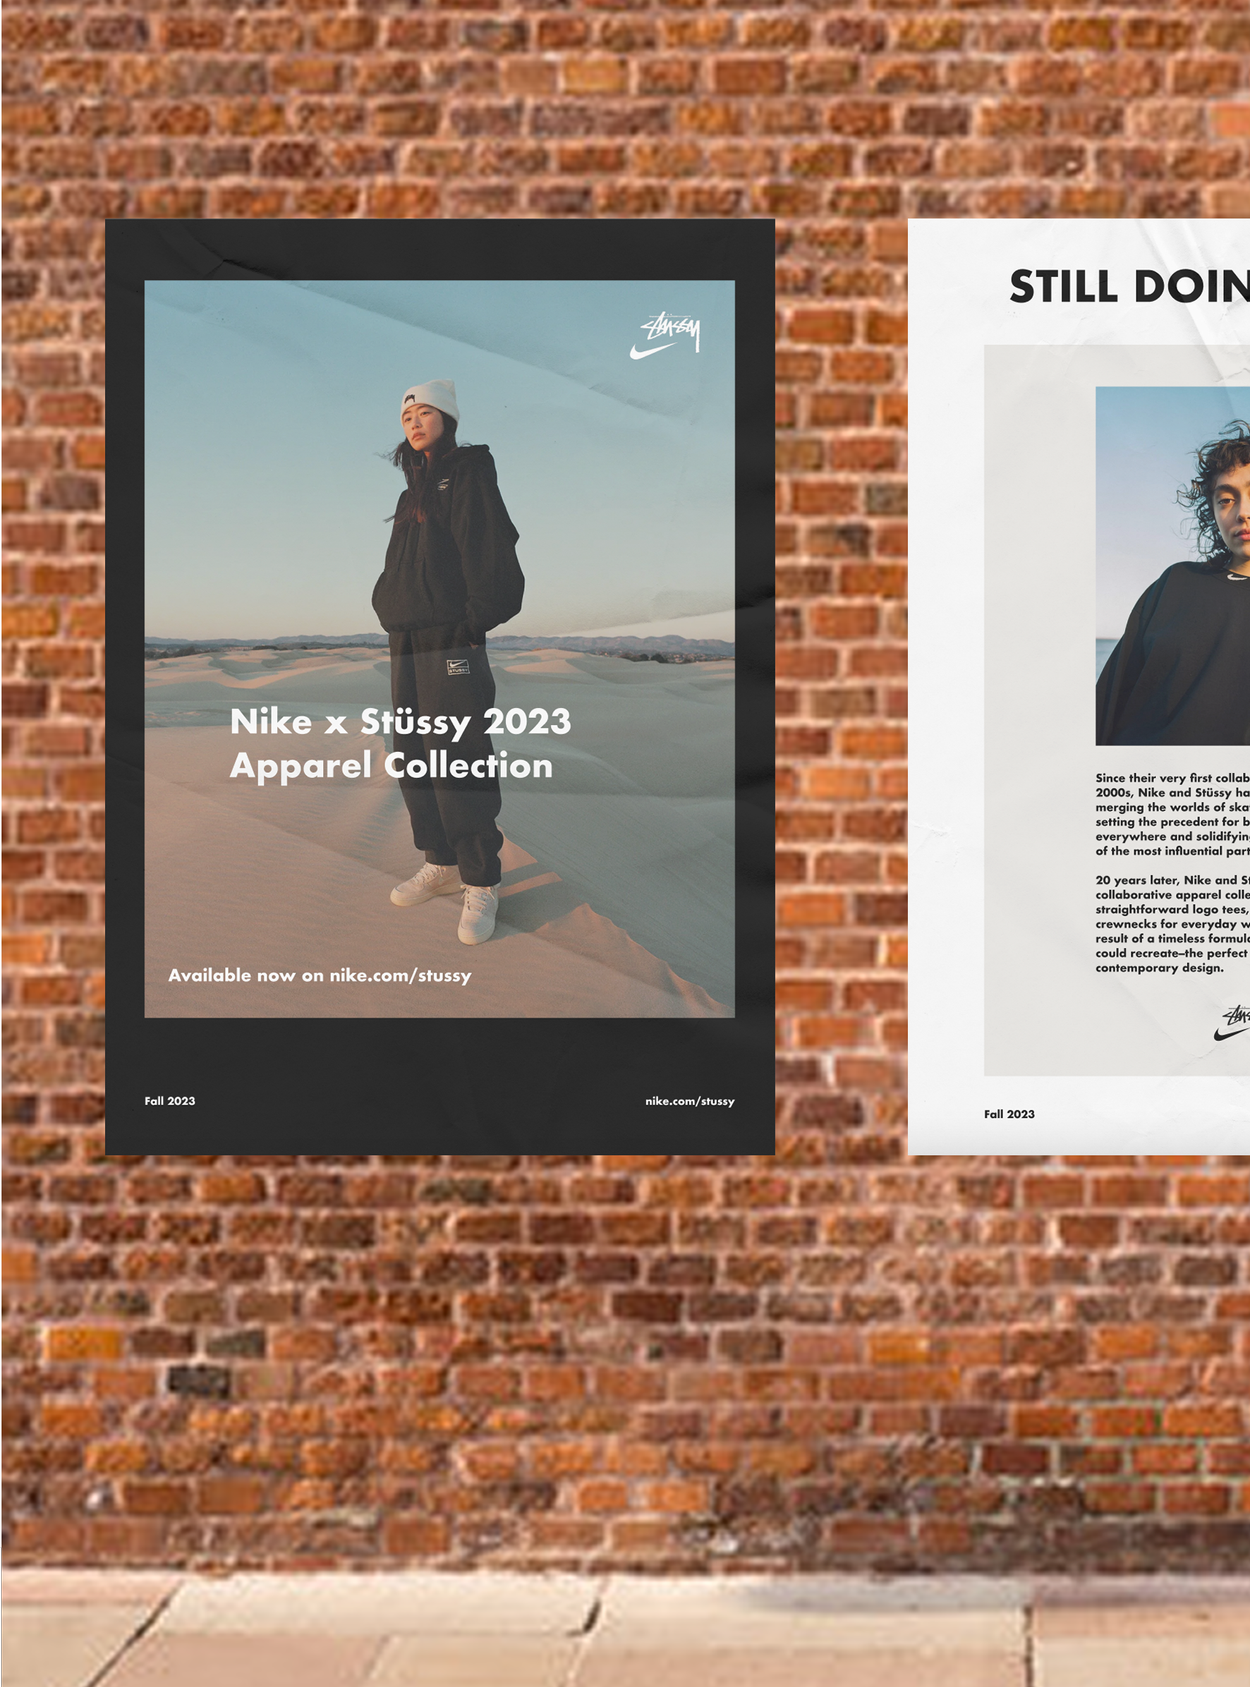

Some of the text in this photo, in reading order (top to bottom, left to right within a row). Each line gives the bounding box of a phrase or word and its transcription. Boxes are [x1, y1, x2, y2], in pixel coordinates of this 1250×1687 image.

[1010, 269, 1117, 303] STILL
[232, 706, 571, 742] Nike x Stüssy 2023
[230, 750, 552, 786] Apparel Collection
[1095, 772, 1126, 783] Since
[1128, 772, 1157, 783] their
[1159, 775, 1187, 786] very
[1189, 772, 1213, 783] first
[1095, 787, 1134, 799] 2000s,
[1138, 786, 1166, 798] Nike
[1168, 786, 1192, 798] and
[1195, 787, 1233, 800] Stüssy
[1095, 801, 1145, 815] merging
[1147, 801, 1167, 813] the
[1169, 801, 1210, 813] worlds
[1213, 801, 1226, 812] of
[1095, 816, 1135, 830] setting
[1138, 816, 1158, 827] the
[1160, 816, 1220, 830] precedent
[1221, 816, 1240, 827] for
[1095, 830, 1167, 844] everywhere
[1170, 830, 1193, 842] and
[1095, 845, 1109, 856] of
[1110, 845, 1130, 856] the
[1133, 847, 1162, 856] most
[1164, 845, 1223, 856] influential
[1095, 875, 1111, 885] 20
[1113, 877, 1147, 888] years
[1150, 874, 1180, 887] later,
[1184, 874, 1212, 886] Nike
[1214, 874, 1238, 885] and
[1095, 889, 1173, 900] collaborative
[1175, 889, 1222, 903] apparel
[1095, 903, 1189, 917] straightforward
[1192, 903, 1219, 917] logo
[1221, 905, 1250, 916] tees,
[1095, 918, 1158, 929] crewnecks
[1160, 918, 1178, 929] for
[1181, 918, 1238, 932] everyday
[1095, 932, 1129, 944] result
[1131, 932, 1144, 944] of
[1146, 936, 1155, 944] a
[1157, 932, 1206, 944] timeless
[1095, 947, 1127, 958] could
[1207, 947, 1249, 961] perfect
[1095, 962, 1225, 976] contemporary design.
[167, 966, 473, 987] Available now on nike.com/stussy
[144, 1095, 196, 1106] Fall 2023
[645, 1095, 736, 1109] nike.com/stussy
[984, 1108, 1036, 1119] Fall 2023
